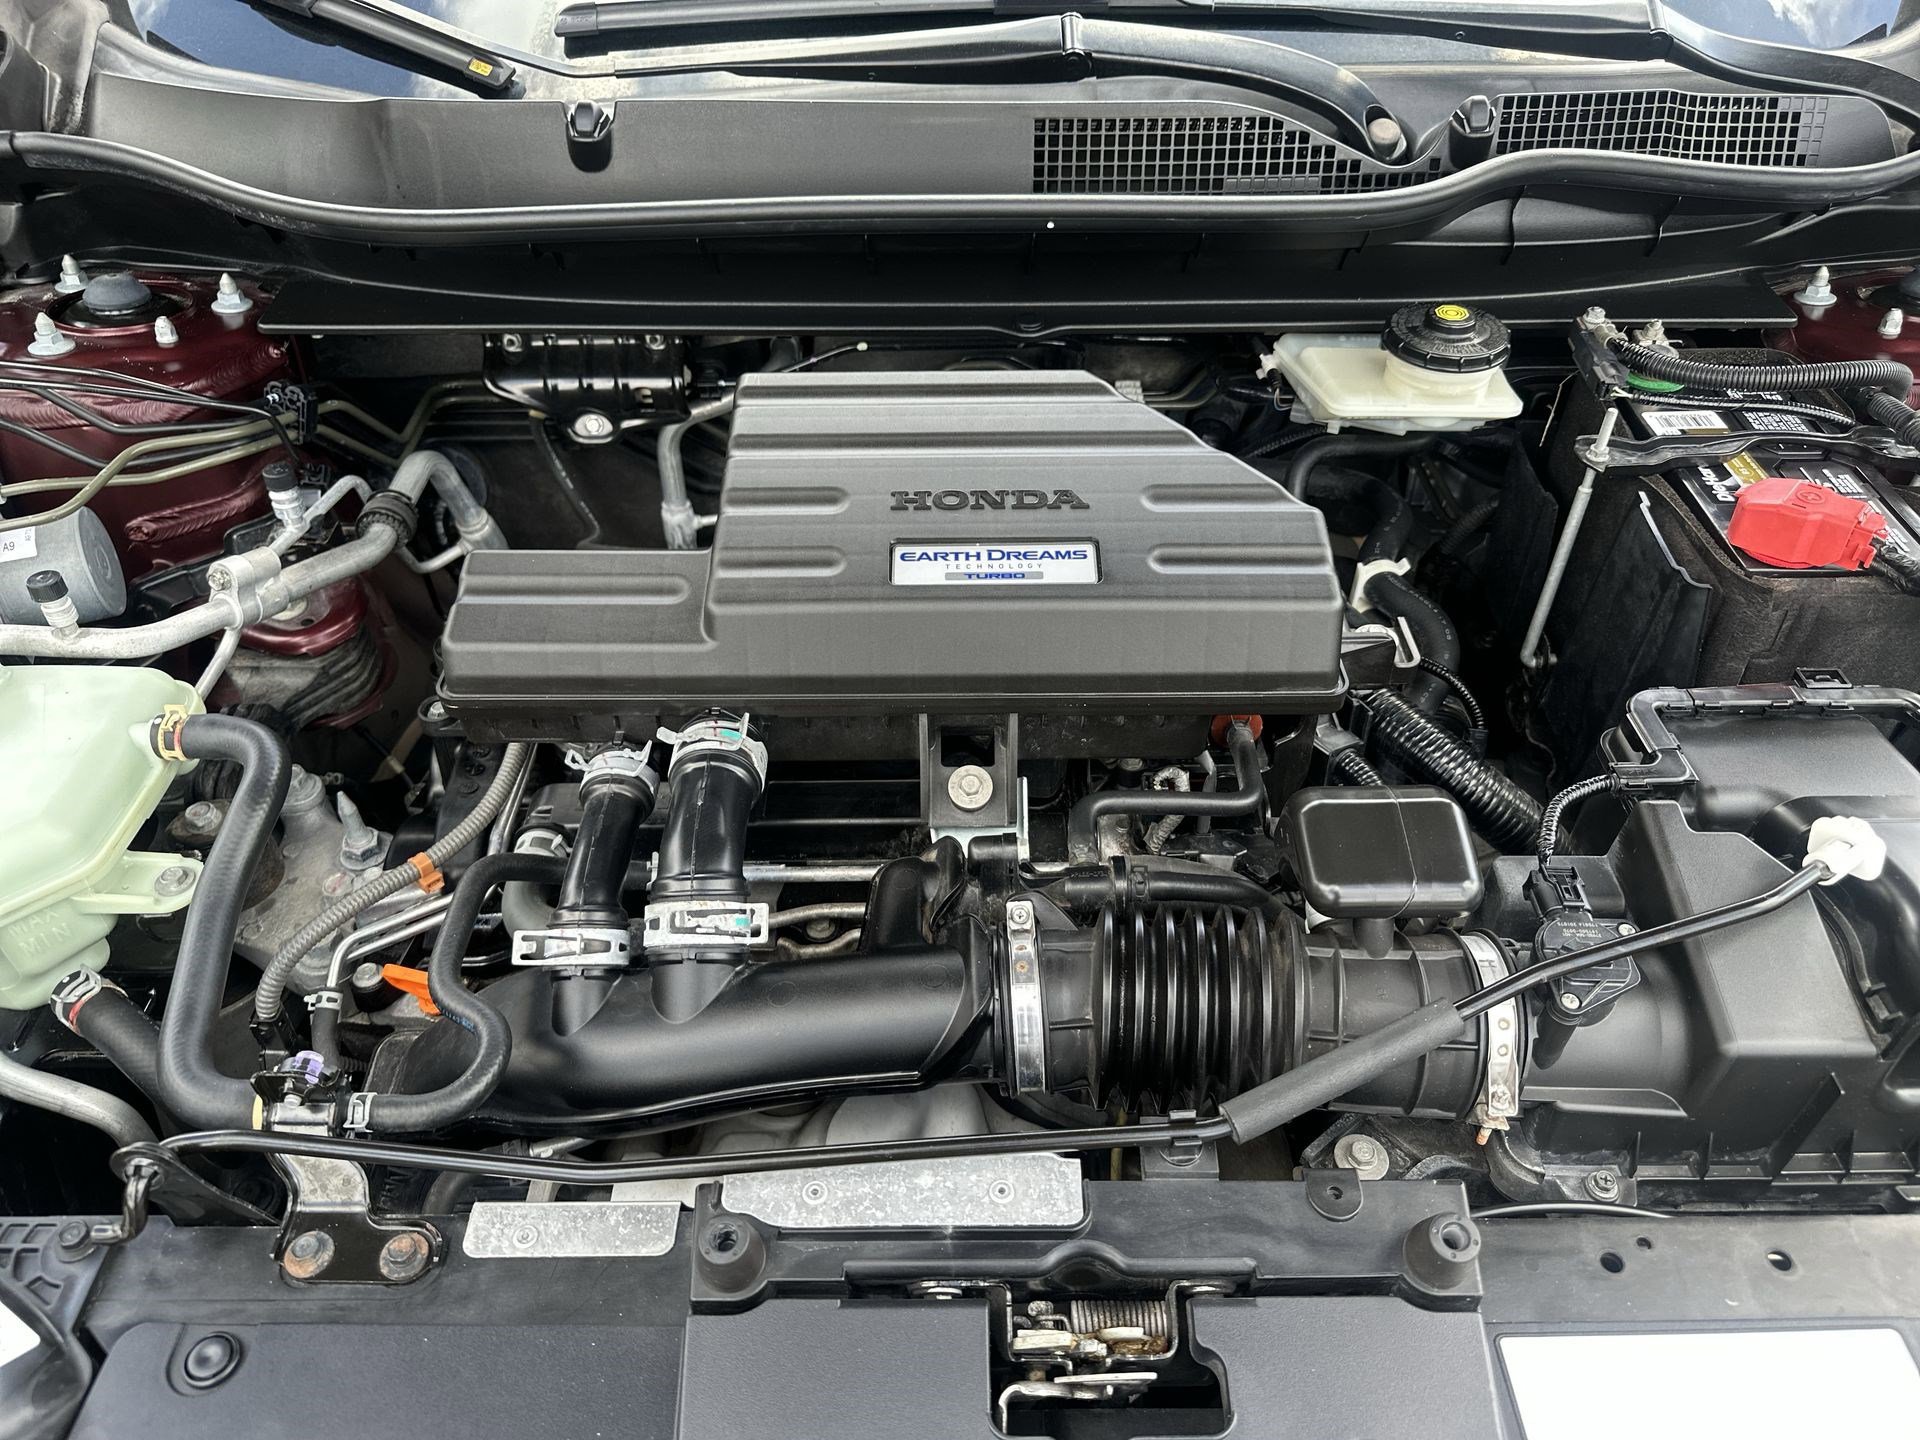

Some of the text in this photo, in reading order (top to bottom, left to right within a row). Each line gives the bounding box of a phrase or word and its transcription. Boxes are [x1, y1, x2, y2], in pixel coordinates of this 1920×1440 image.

[1697, 466, 1735, 502] DieHar
[890, 489, 1090, 511] HONDA
[899, 549, 1089, 562] EARTH DREAMS
[964, 572, 1025, 580] TURBO
[8, 912, 60, 937] MAX
[18, 922, 72, 957] MIN
